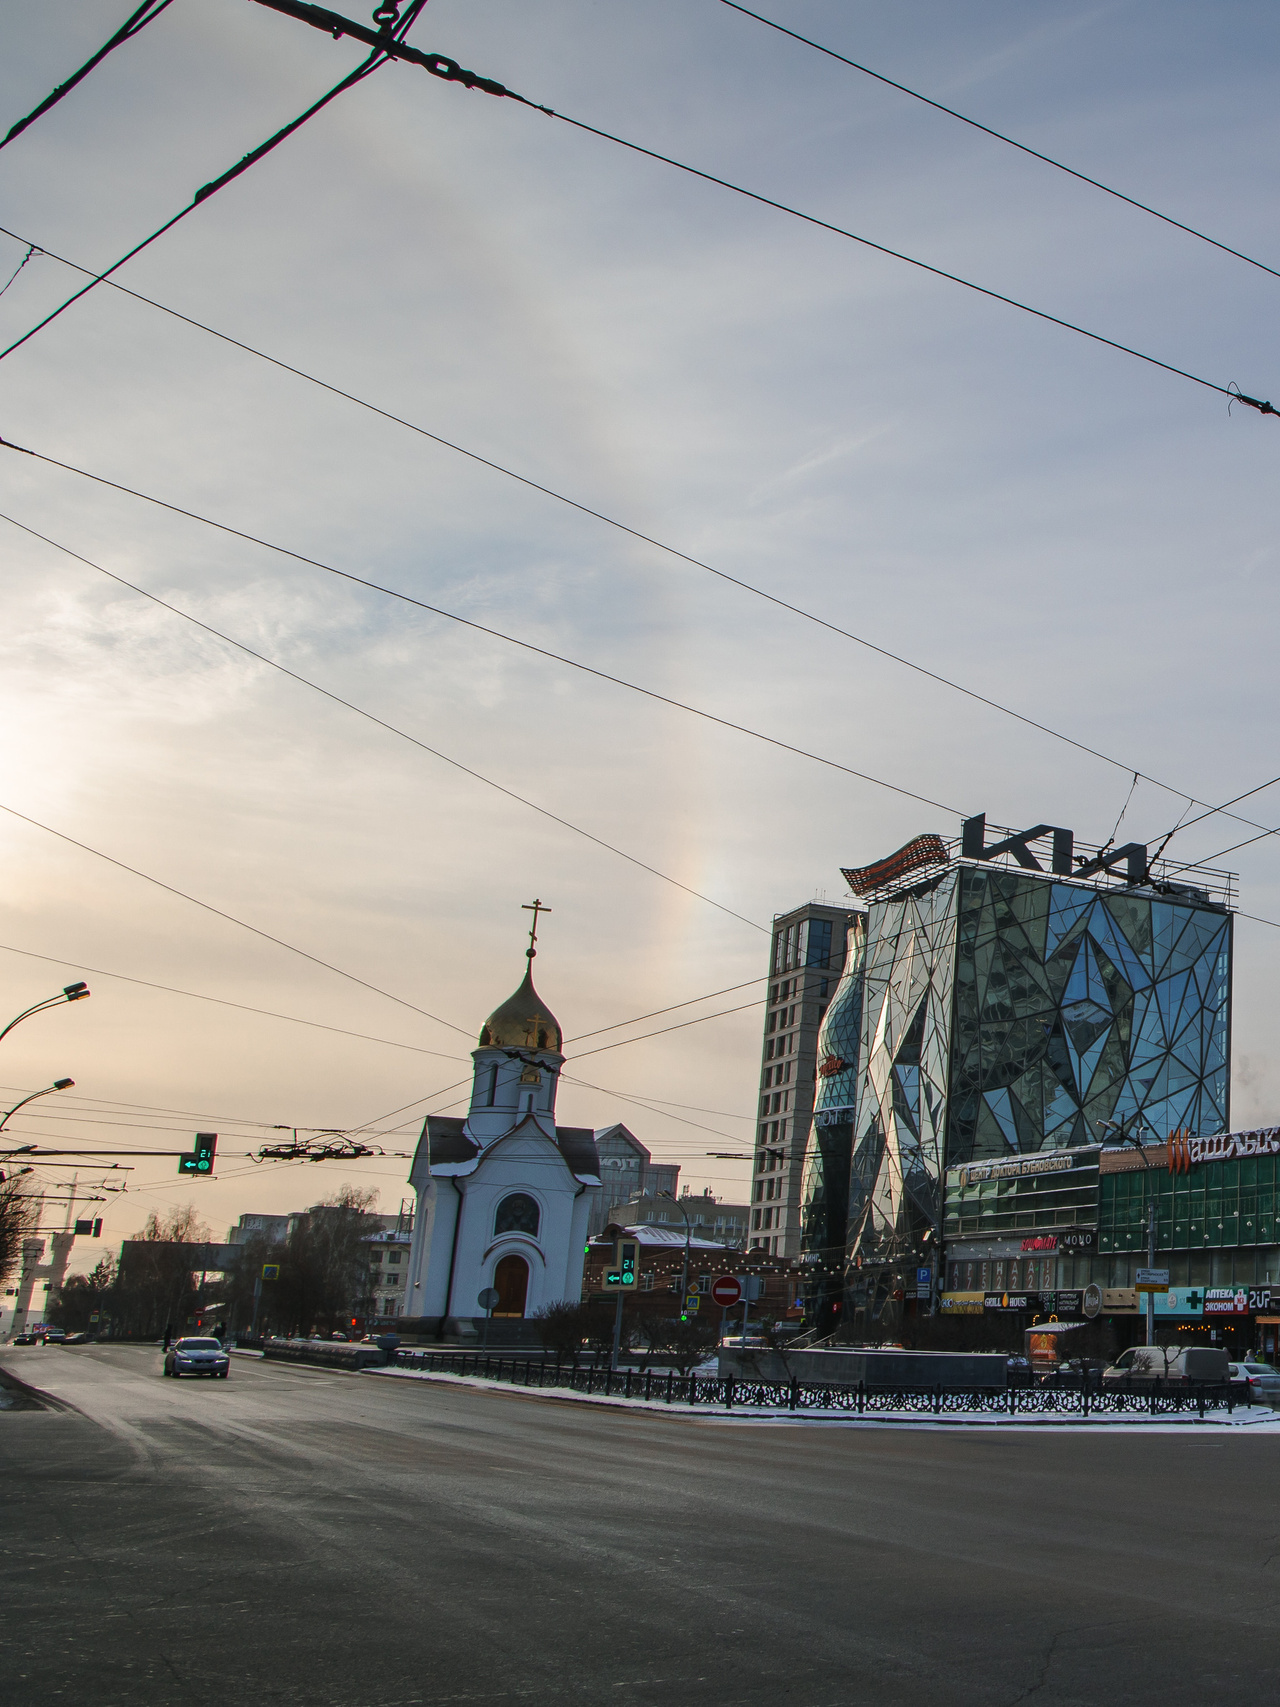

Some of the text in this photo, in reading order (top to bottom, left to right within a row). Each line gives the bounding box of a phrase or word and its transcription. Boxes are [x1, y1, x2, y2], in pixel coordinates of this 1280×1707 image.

[971, 1156, 1073, 1181] ЦЕНТР ДОКТОРА БУБНОВСКОГО
[623, 1259, 634, 1269] 21
[1205, 1288, 1235, 1299] АПТЕКА
[985, 1297, 1002, 1307] GRILL
[1205, 1302, 1235, 1312] ЭКОНОМ
